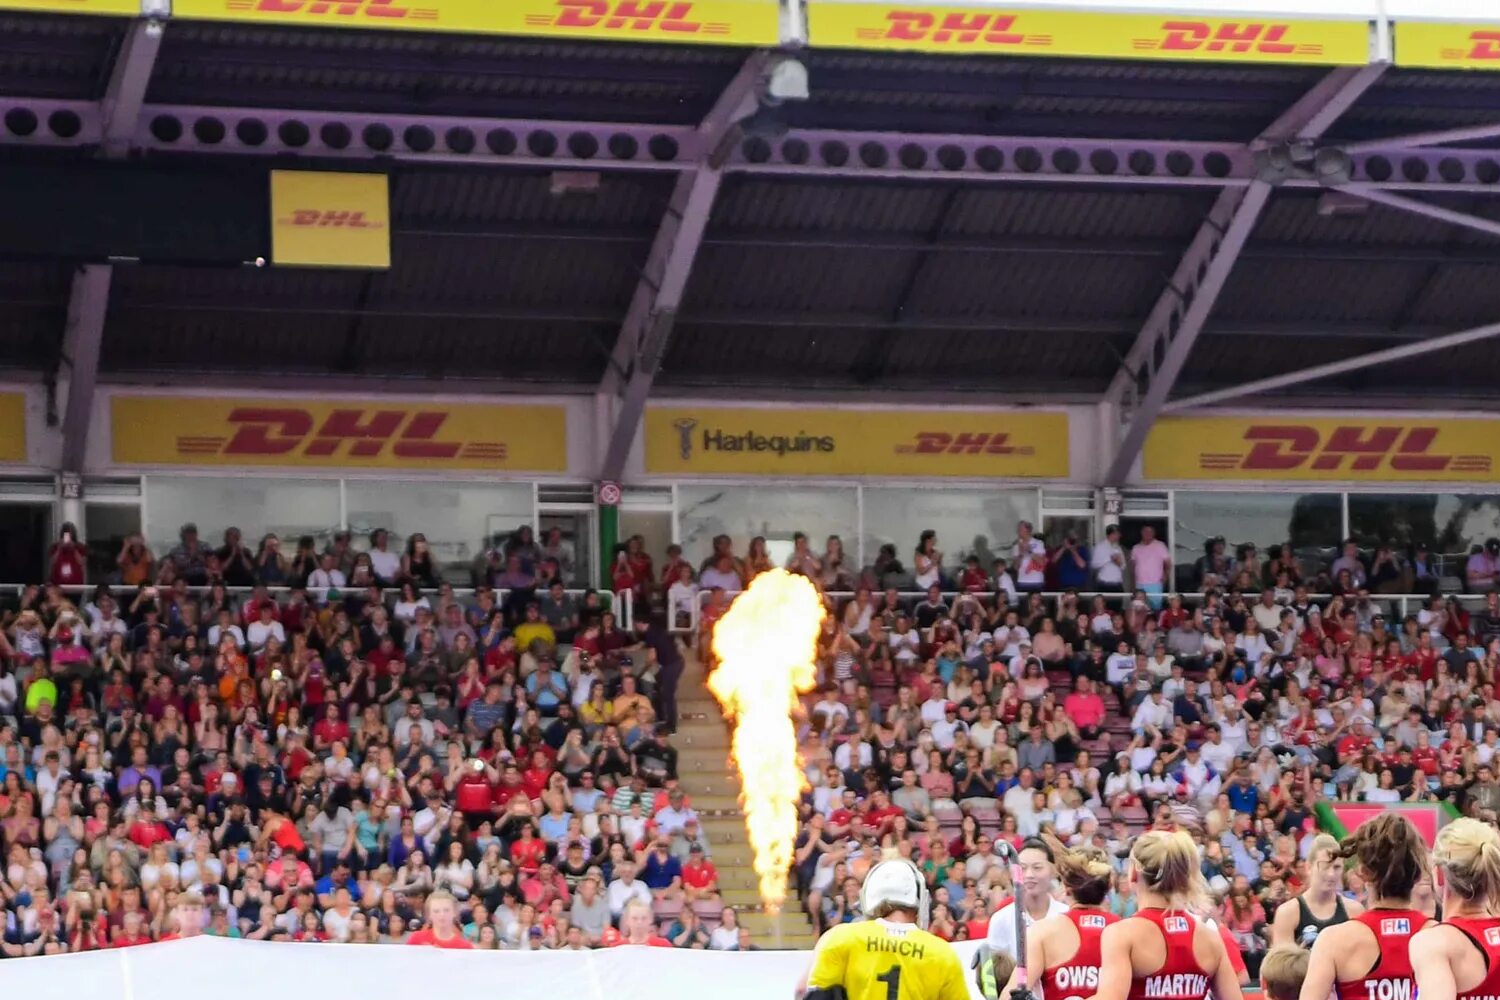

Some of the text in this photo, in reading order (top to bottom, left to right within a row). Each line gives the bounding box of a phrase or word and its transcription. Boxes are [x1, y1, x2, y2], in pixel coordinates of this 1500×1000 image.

[553, 0, 702, 34] DHL
[883, 11, 1027, 46] DHL
[1159, 20, 1299, 55] DHL
[290, 209, 368, 229] DHL
[223, 408, 462, 458] DHL
[703, 428, 834, 456] Harlequins
[913, 432, 1016, 456] DHL
[1241, 425, 1451, 471] DHL
[867, 937, 924, 960] HINCH
[1055, 966, 1102, 989] OWS
[1145, 974, 1208, 998] MARTIN
